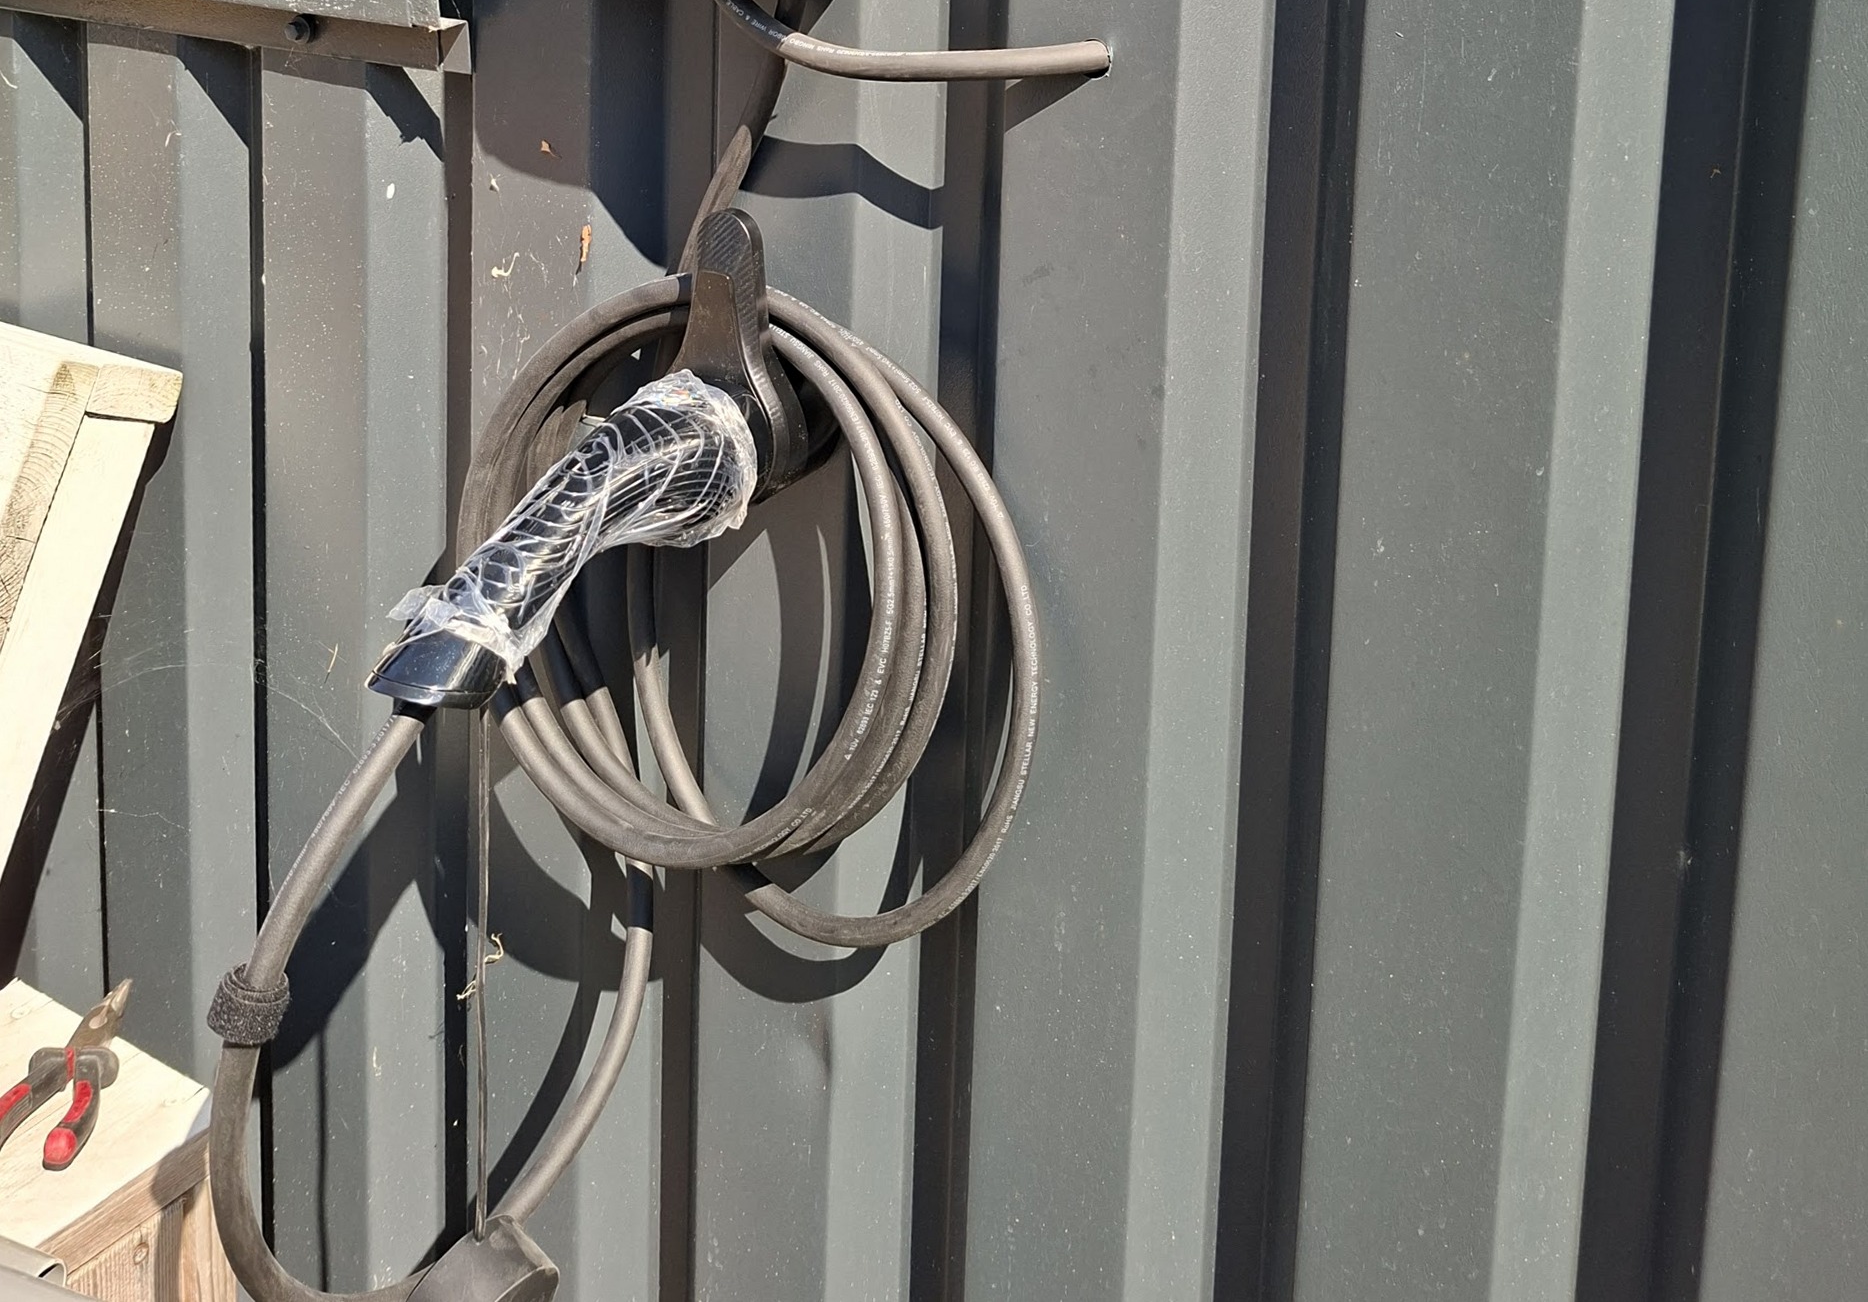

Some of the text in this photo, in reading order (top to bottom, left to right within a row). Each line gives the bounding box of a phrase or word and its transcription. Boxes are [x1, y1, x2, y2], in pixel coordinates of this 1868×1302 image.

[725, 0, 745, 17] CABLE
[789, 37, 816, 50] NINGBO
[789, 337, 815, 359] JIANGSU
[813, 359, 830, 378] RoHS
[1025, 620, 1038, 677] TECHNOLOGY
[876, 657, 887, 674] EVC
[1029, 680, 1039, 715] ENERGY
[1027, 718, 1036, 737] NEW
[1019, 741, 1033, 776] STELLAR
[1010, 779, 1025, 811] JIANGSU
[1000, 814, 1014, 834] RoHS
